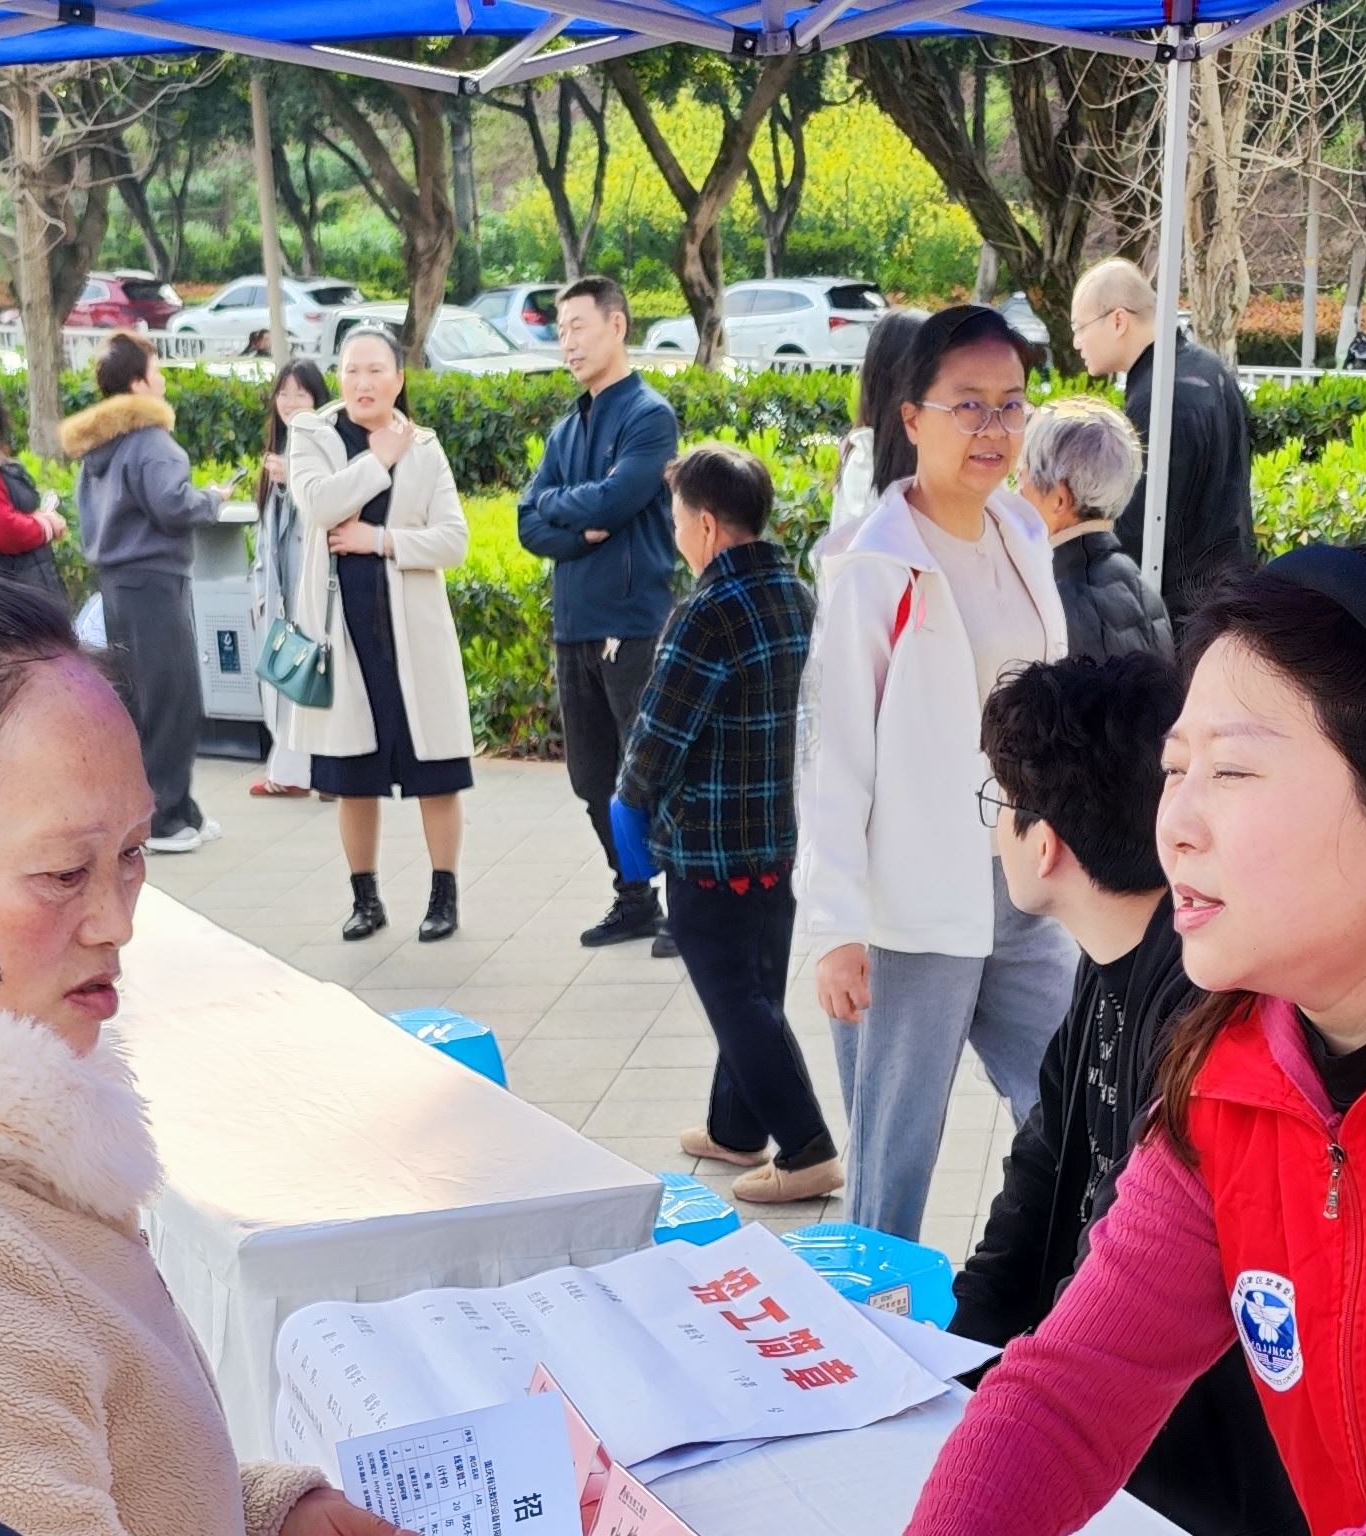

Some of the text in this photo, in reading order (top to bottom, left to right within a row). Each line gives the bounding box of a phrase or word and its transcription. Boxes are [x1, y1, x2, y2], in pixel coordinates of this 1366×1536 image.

[680, 1266, 865, 1392] 招工简章
[451, 1500, 460, 1511] 20
